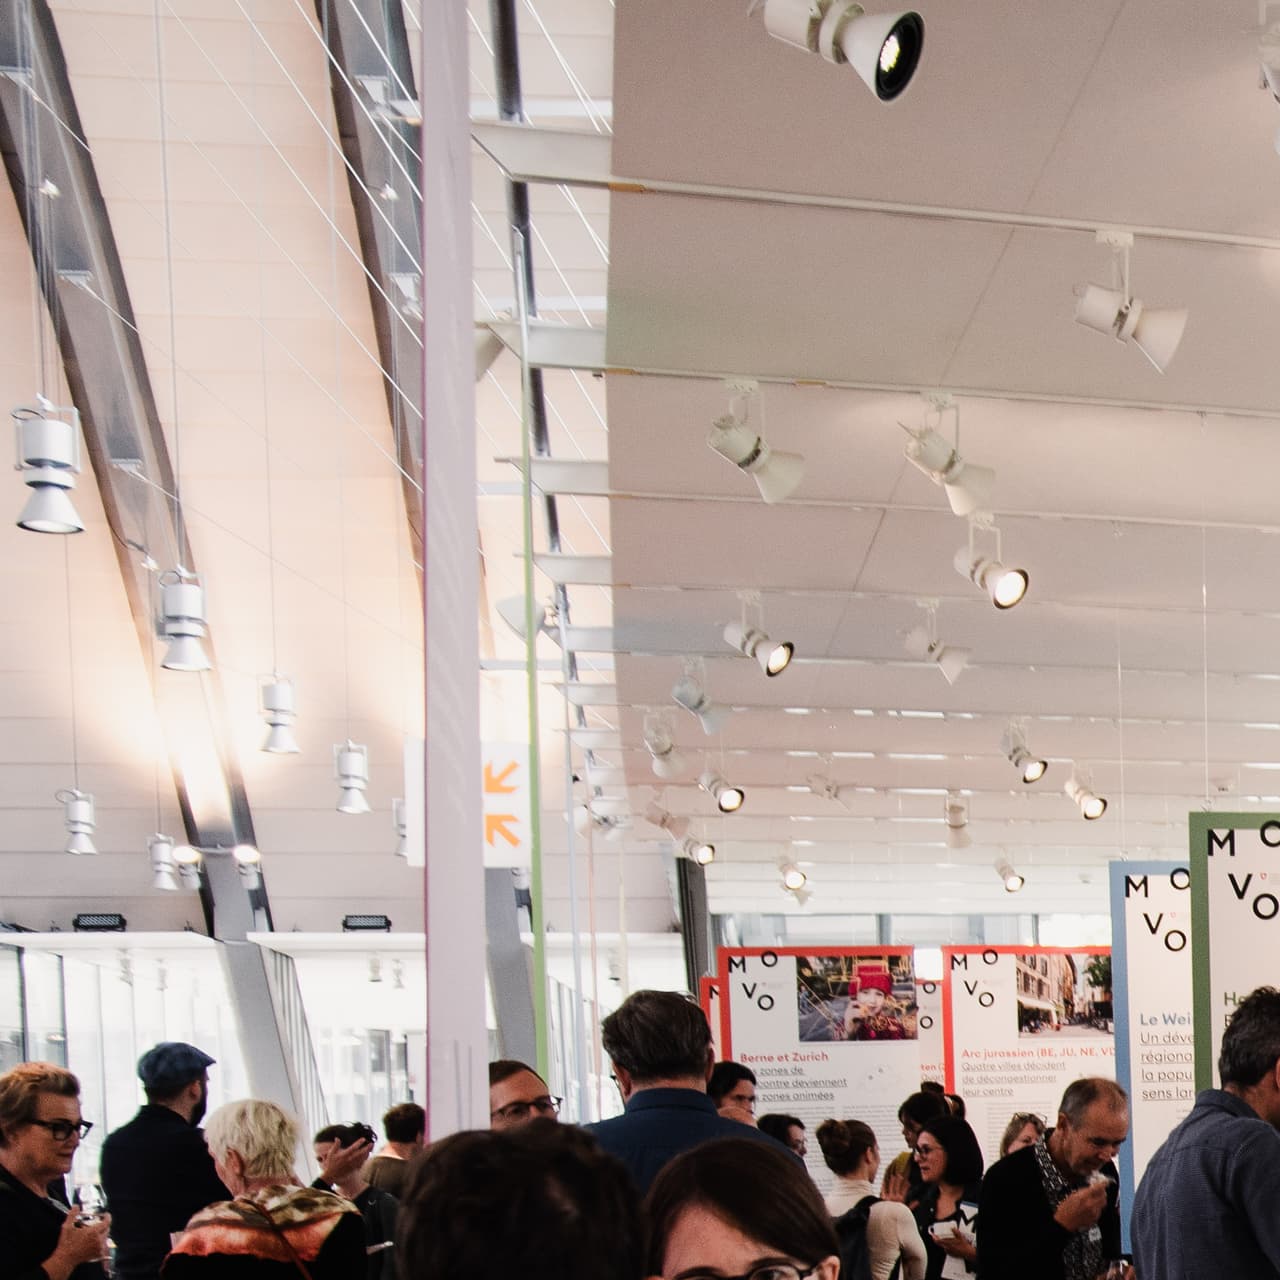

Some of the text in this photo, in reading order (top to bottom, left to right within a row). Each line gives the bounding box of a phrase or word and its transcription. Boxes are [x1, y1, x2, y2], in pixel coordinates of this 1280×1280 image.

[1208, 829, 1235, 856] M
[1125, 868, 1190, 898] M O
[1228, 874, 1280, 920] V O
[1144, 913, 1186, 951] V O
[728, 951, 778, 973] M O
[952, 950, 998, 970] M O
[742, 983, 774, 1010] V O
[964, 980, 994, 1008] V O
[1140, 1013, 1158, 1026] Le
[1140, 1032, 1159, 1044] Un
[740, 1052, 828, 1063] Berne et Zurich
[962, 1050, 980, 1058] Arc
[984, 1048, 1034, 1060] jurassien
[791, 1066, 803, 1075] de
[1142, 1070, 1152, 1081] la
[794, 1078, 848, 1088] deviennent
[962, 1075, 976, 1084] de
[1142, 1090, 1172, 1099] sens
